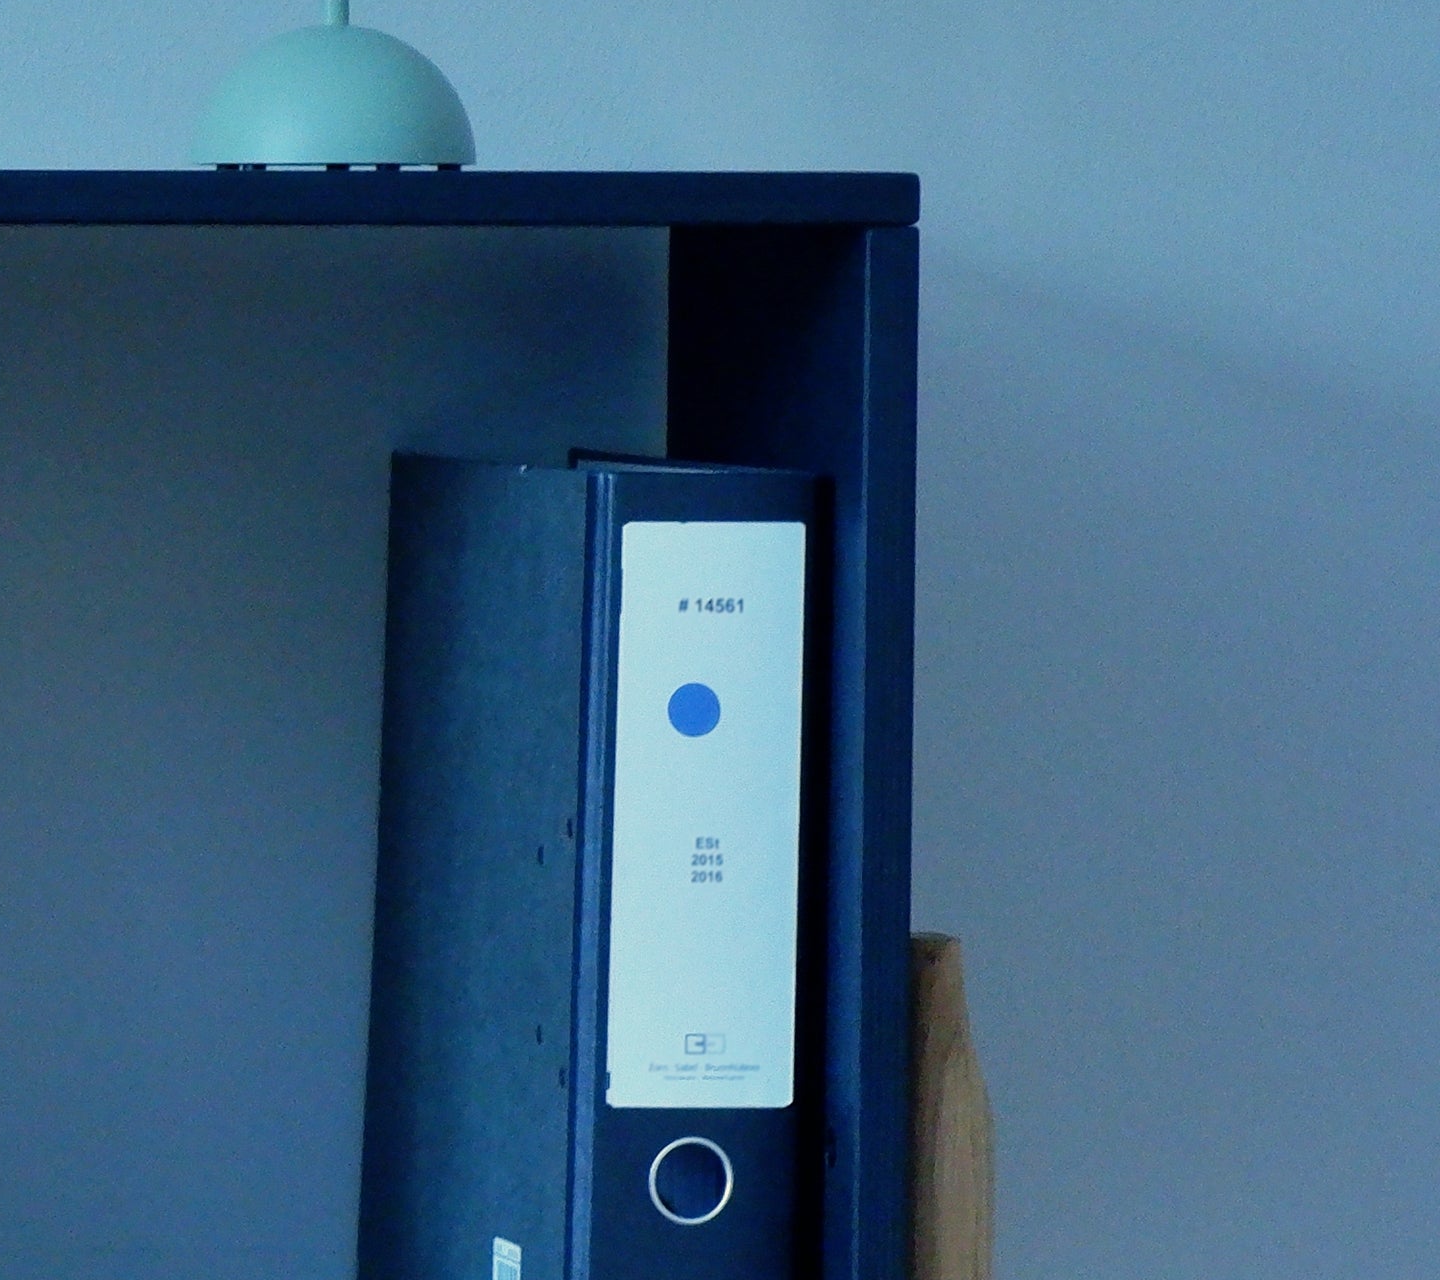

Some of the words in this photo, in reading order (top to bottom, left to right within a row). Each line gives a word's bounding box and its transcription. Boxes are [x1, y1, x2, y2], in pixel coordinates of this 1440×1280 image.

[694, 597, 745, 614] 14561
[690, 853, 724, 867] 2015
[690, 870, 723, 884] 2016
